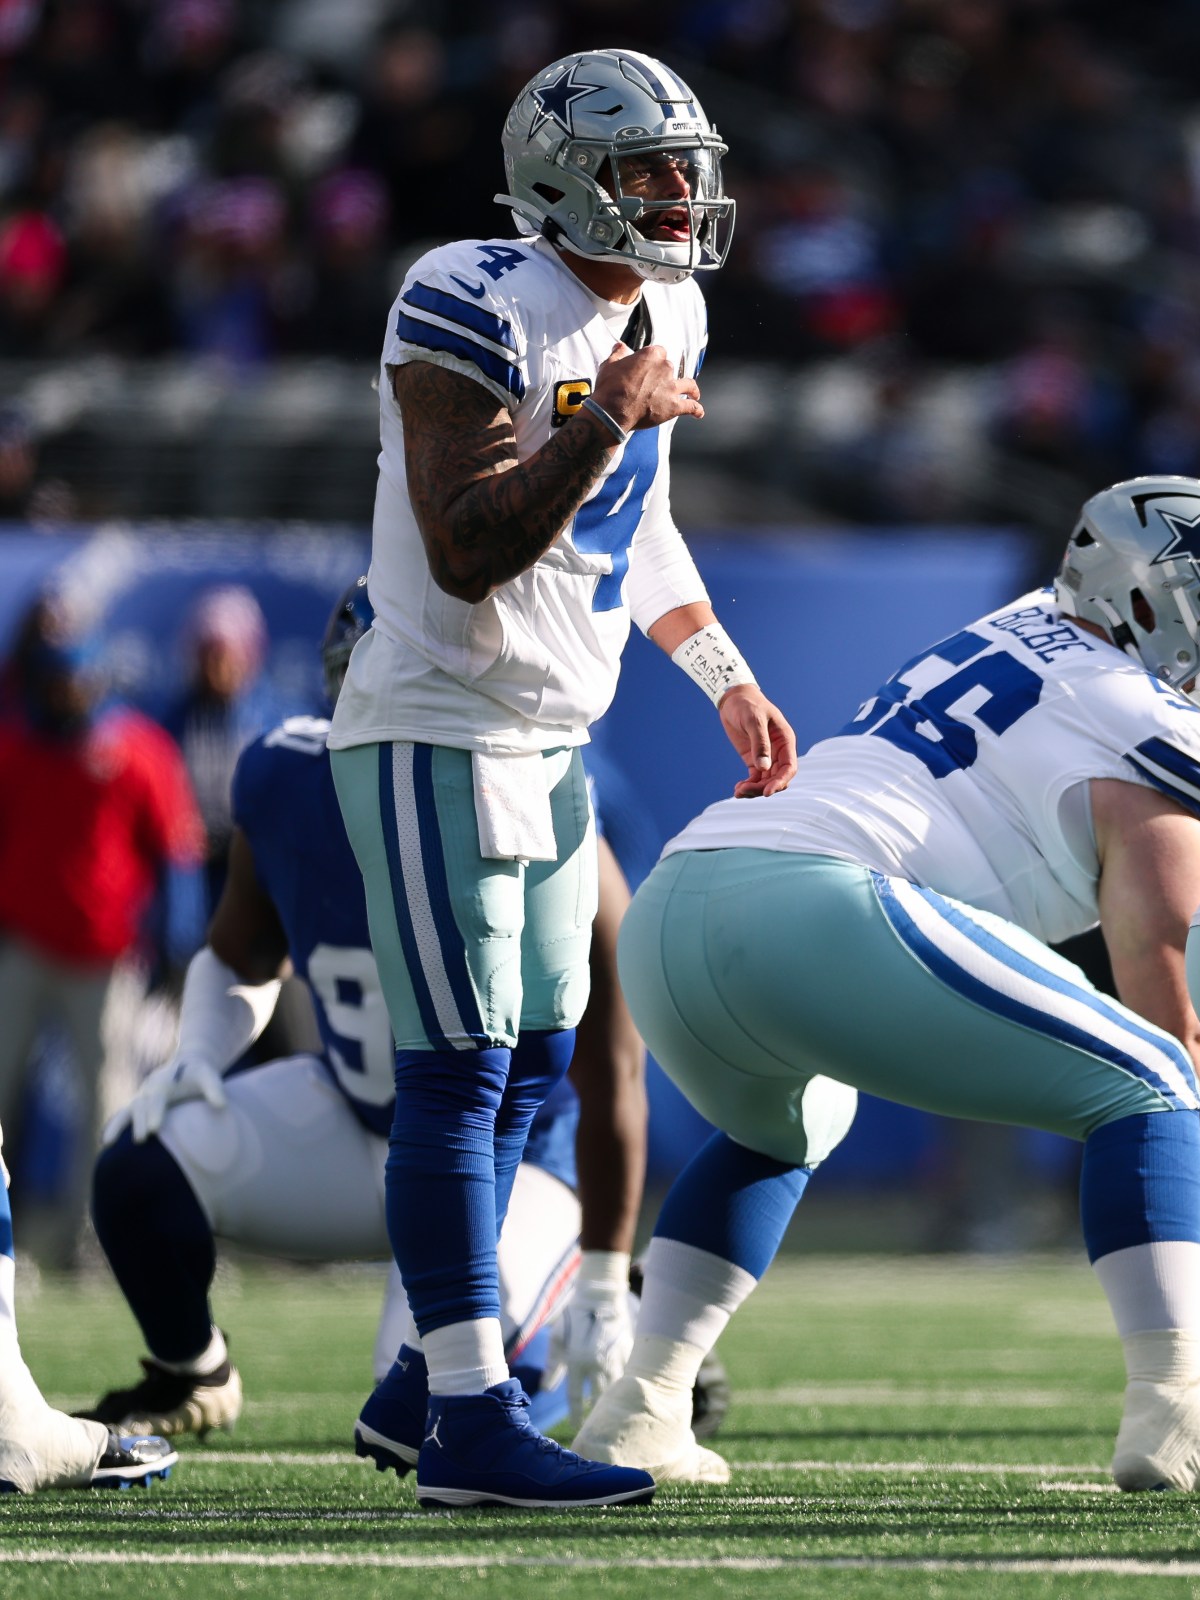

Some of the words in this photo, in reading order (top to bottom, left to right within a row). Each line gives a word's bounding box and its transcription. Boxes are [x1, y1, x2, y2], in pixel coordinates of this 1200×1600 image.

[475, 245, 529, 281] 4
[556, 381, 592, 416] C
[571, 426, 660, 613] 4
[834, 630, 1045, 781] 56
